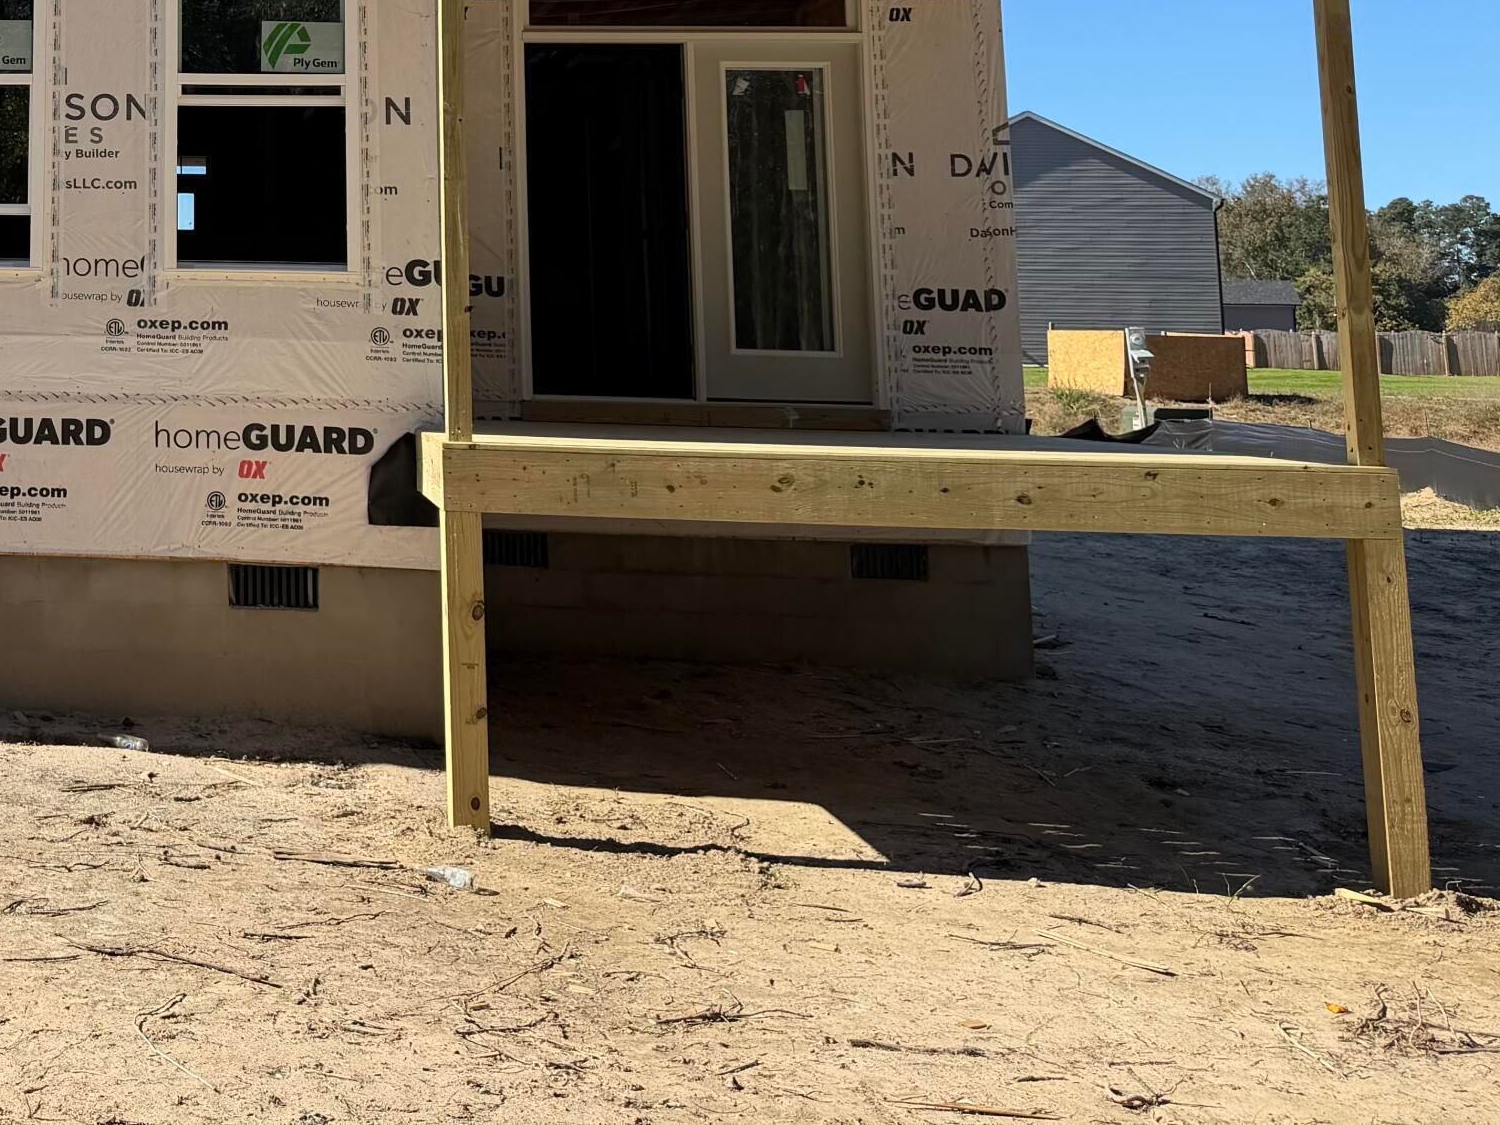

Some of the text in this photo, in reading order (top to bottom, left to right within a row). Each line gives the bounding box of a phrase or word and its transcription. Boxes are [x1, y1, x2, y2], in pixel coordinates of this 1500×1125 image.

[889, 7, 912, 22] OX
[2, 56, 26, 65] Gem
[293, 58, 338, 69] Ply Gem
[76, 149, 120, 158] Builder
[62, 291, 122, 303] ousewrap by
[391, 297, 421, 316] OX
[137, 318, 229, 332] oxep.com
[902, 320, 927, 335] OX
[912, 345, 993, 356] oxep.com
[155, 420, 374, 455] homeGUARD
[155, 459, 268, 479] housewrap by OX
[238, 492, 329, 507] oxep.com
[237, 507, 276, 515] HomeGuard
